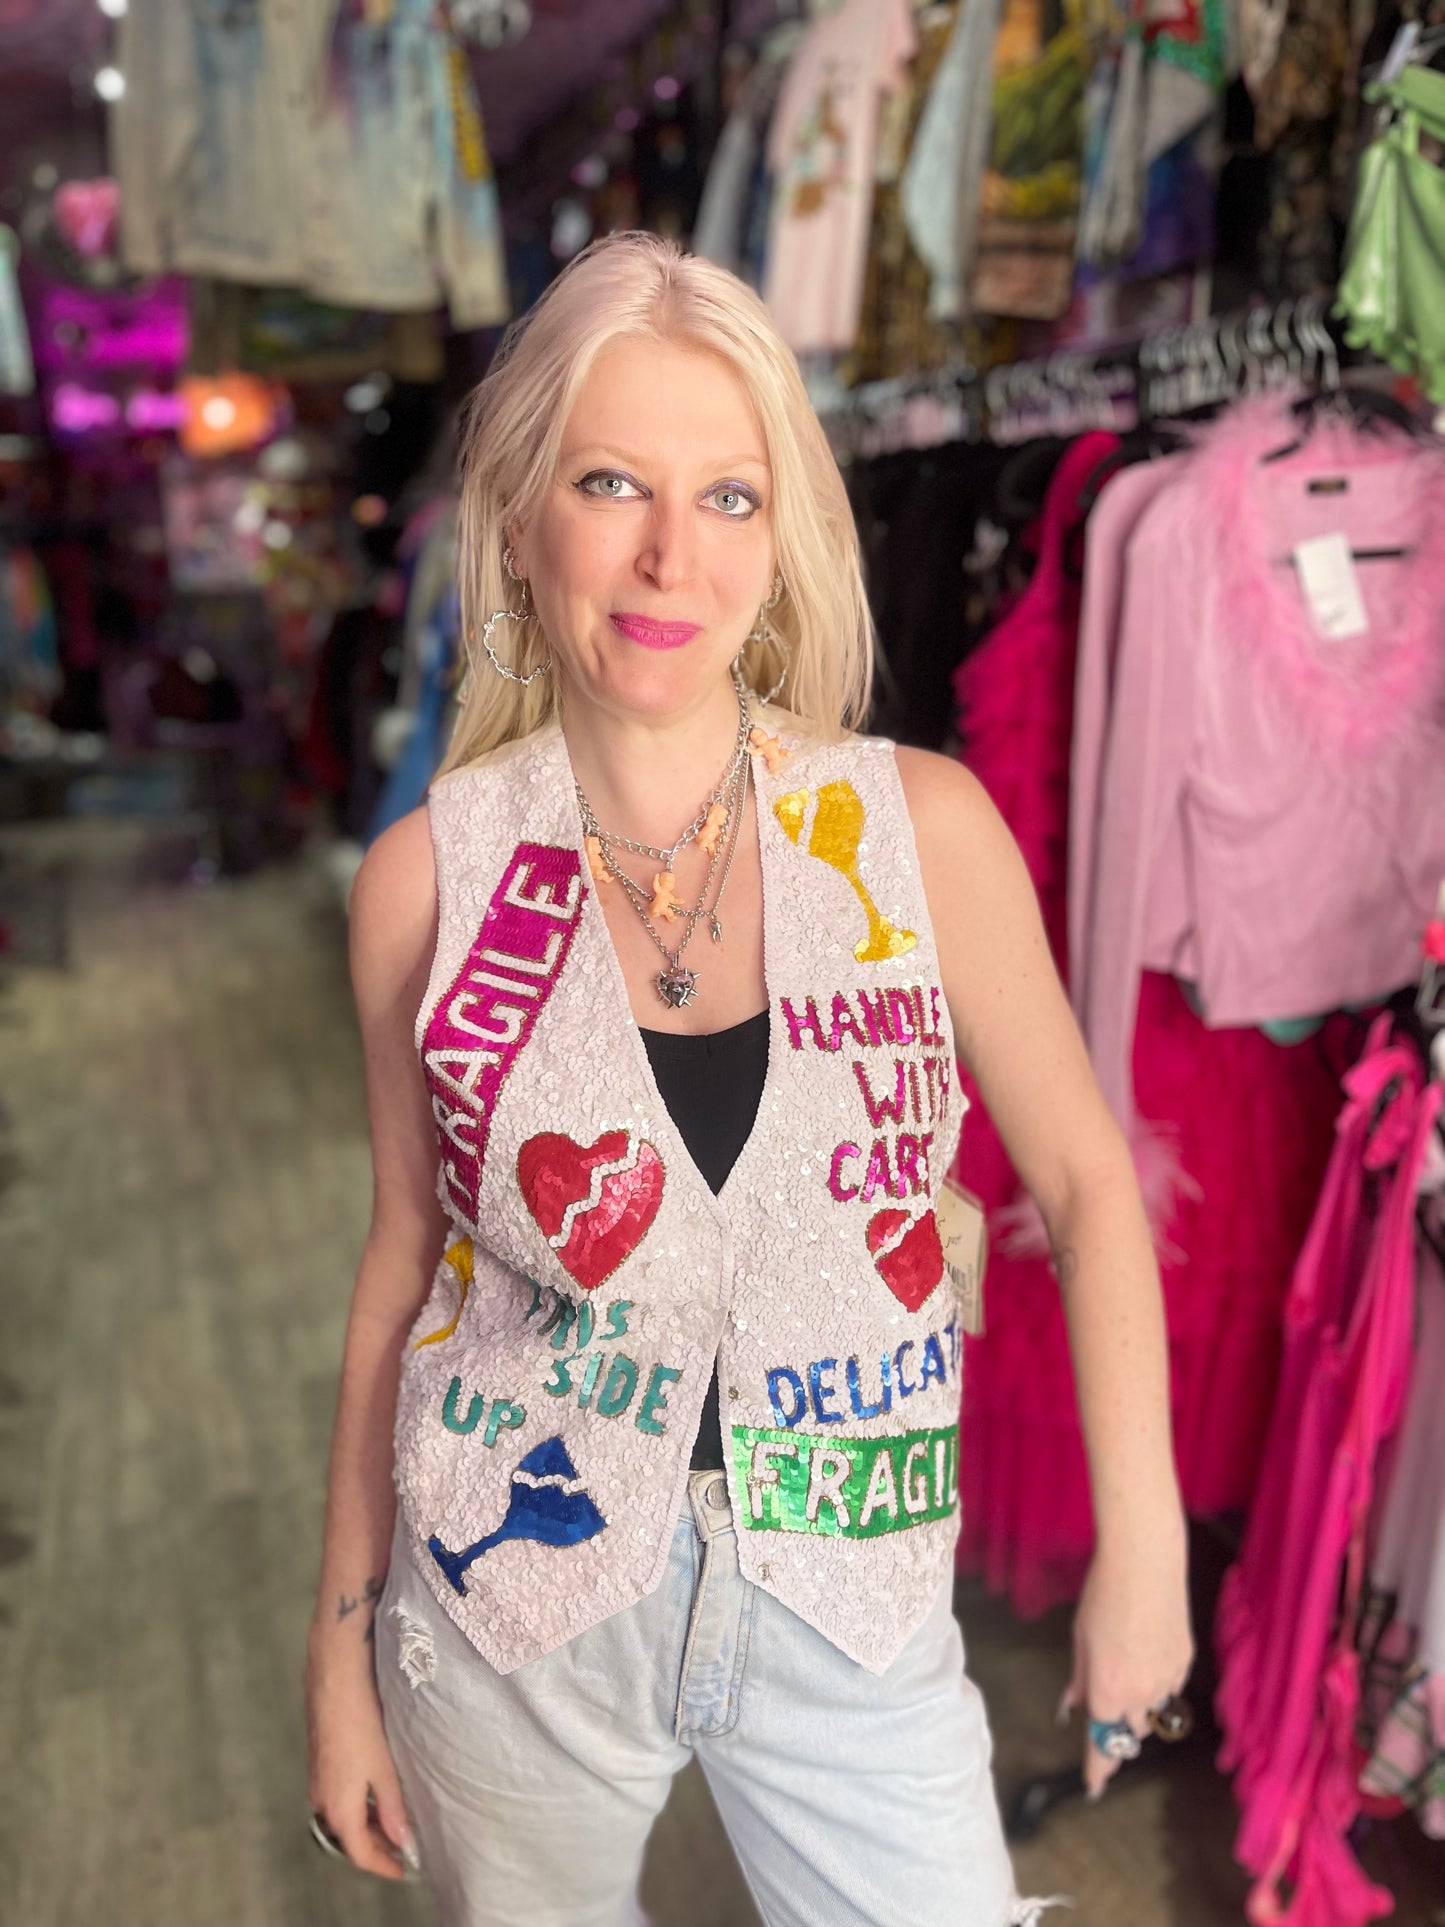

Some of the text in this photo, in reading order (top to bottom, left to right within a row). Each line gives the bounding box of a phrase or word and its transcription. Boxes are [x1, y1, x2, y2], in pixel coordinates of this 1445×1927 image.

[442, 1376, 528, 1448] UP
[542, 1351, 682, 1435] SIDE
[750, 1436, 958, 1528] FRAGIL
